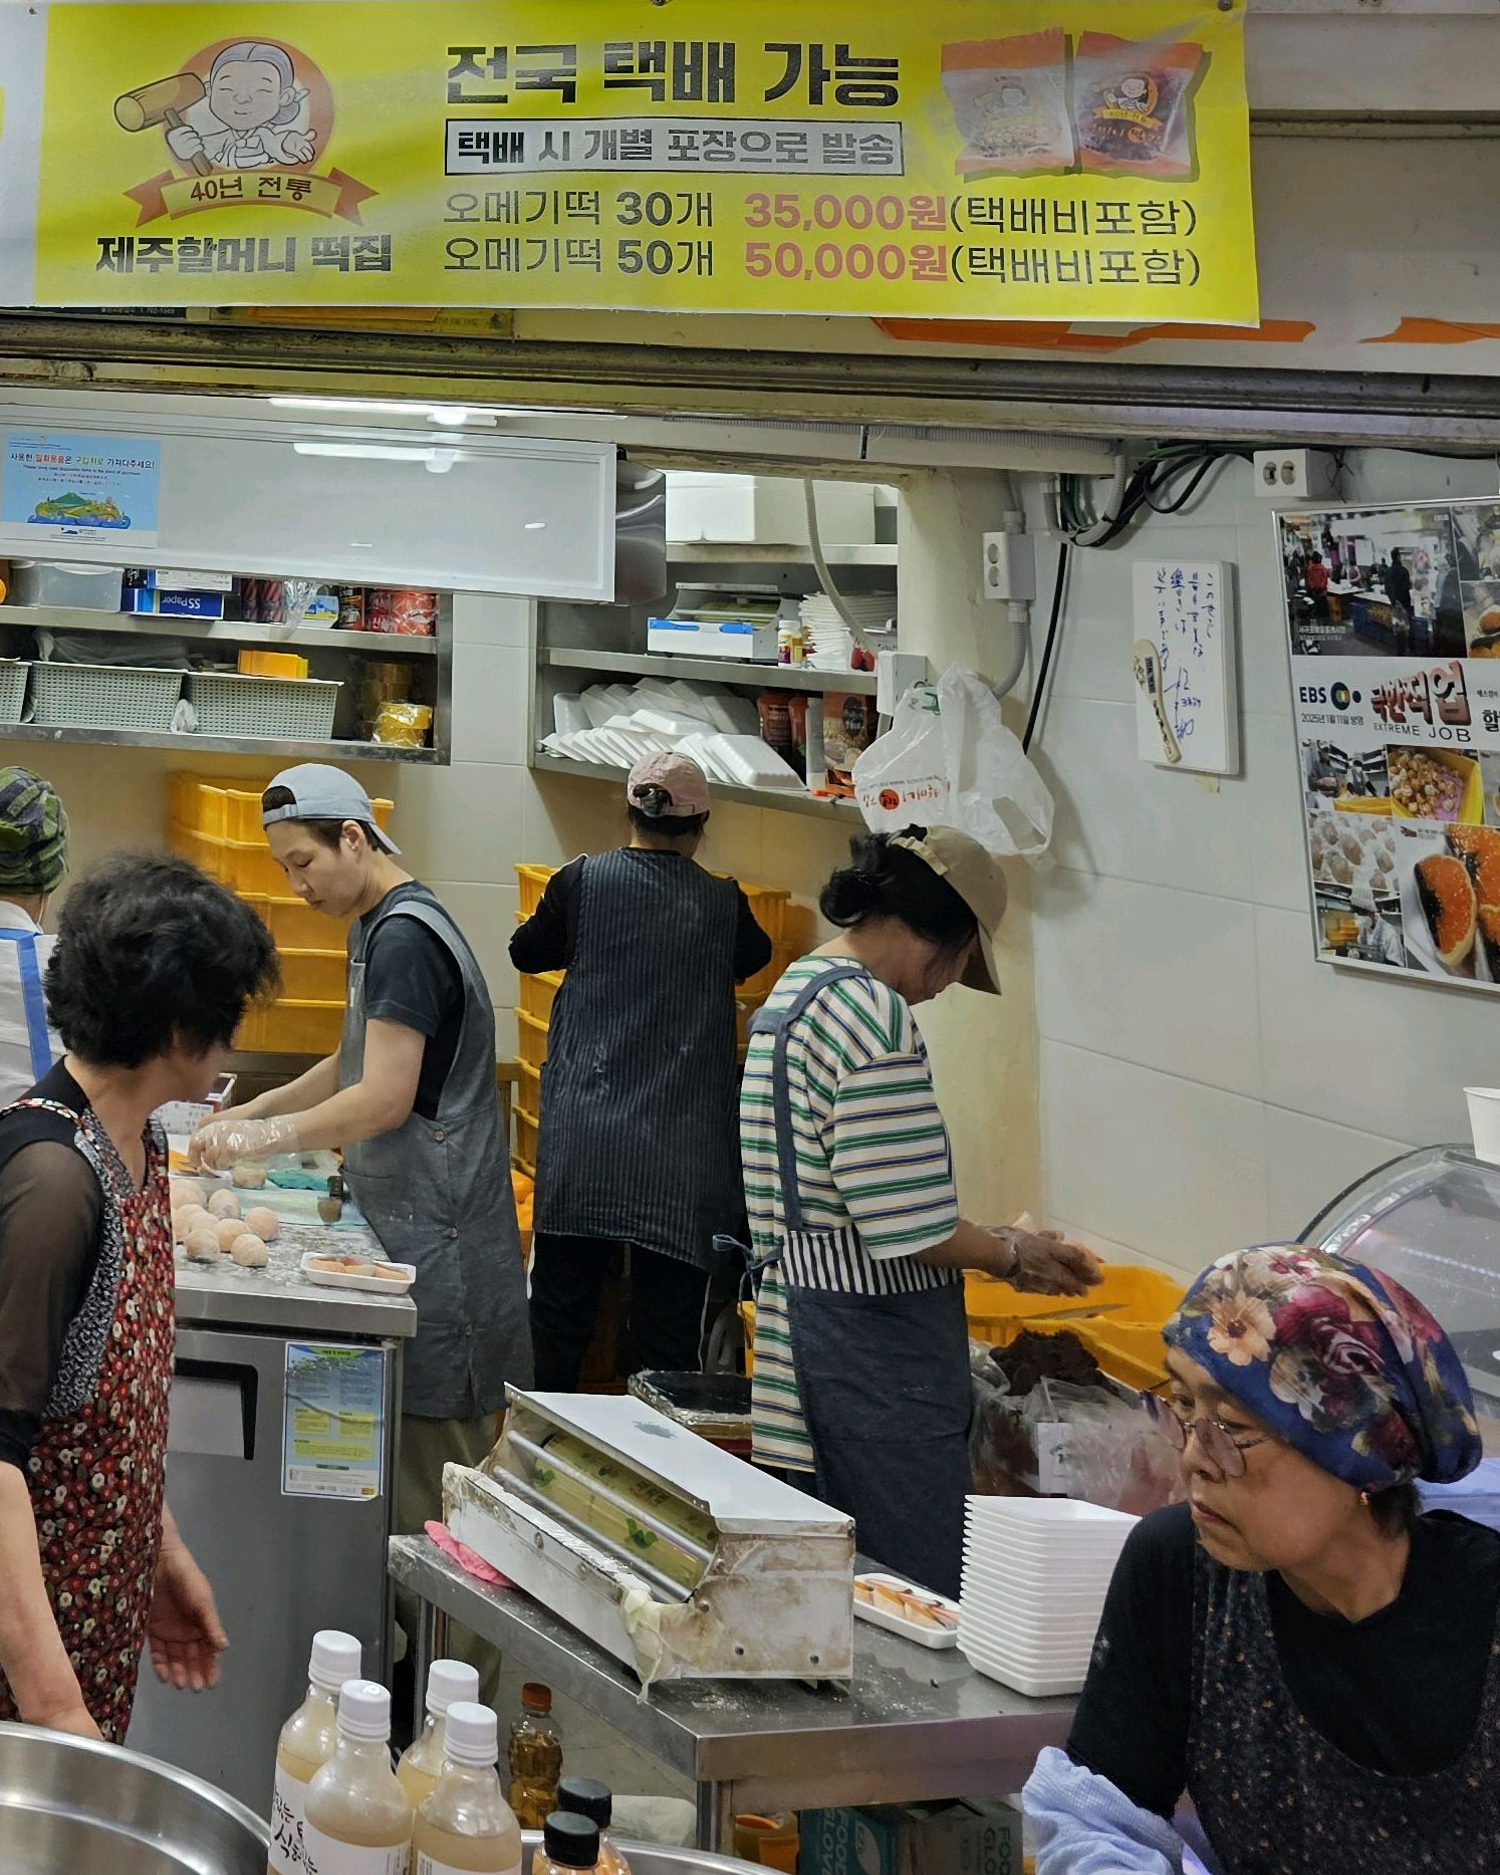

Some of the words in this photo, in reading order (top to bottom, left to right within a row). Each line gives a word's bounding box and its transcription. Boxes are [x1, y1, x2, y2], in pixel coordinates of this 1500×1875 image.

[446, 44, 579, 105] 전국
[604, 41, 735, 103] 택배
[763, 43, 900, 107] 가능
[457, 130, 525, 165] 택배
[537, 131, 572, 163] 시
[584, 128, 652, 162] 개별
[667, 130, 810, 166] 포장으로
[821, 131, 894, 166] 발송
[190, 176, 257, 202] 40년
[257, 175, 313, 202] 전통
[444, 191, 601, 226] 오메기떡
[616, 191, 713, 228] 30개
[96, 235, 296, 274] 제주할머니
[311, 234, 392, 274] 떡집
[444, 237, 601, 275] 오메기떡
[618, 240, 713, 277] 50개
[1299, 687, 1327, 704] EBS
[1370, 660, 1472, 726] 극한직업
[1374, 723, 1420, 736] EXTREME
[1429, 726, 1472, 742] JOB
